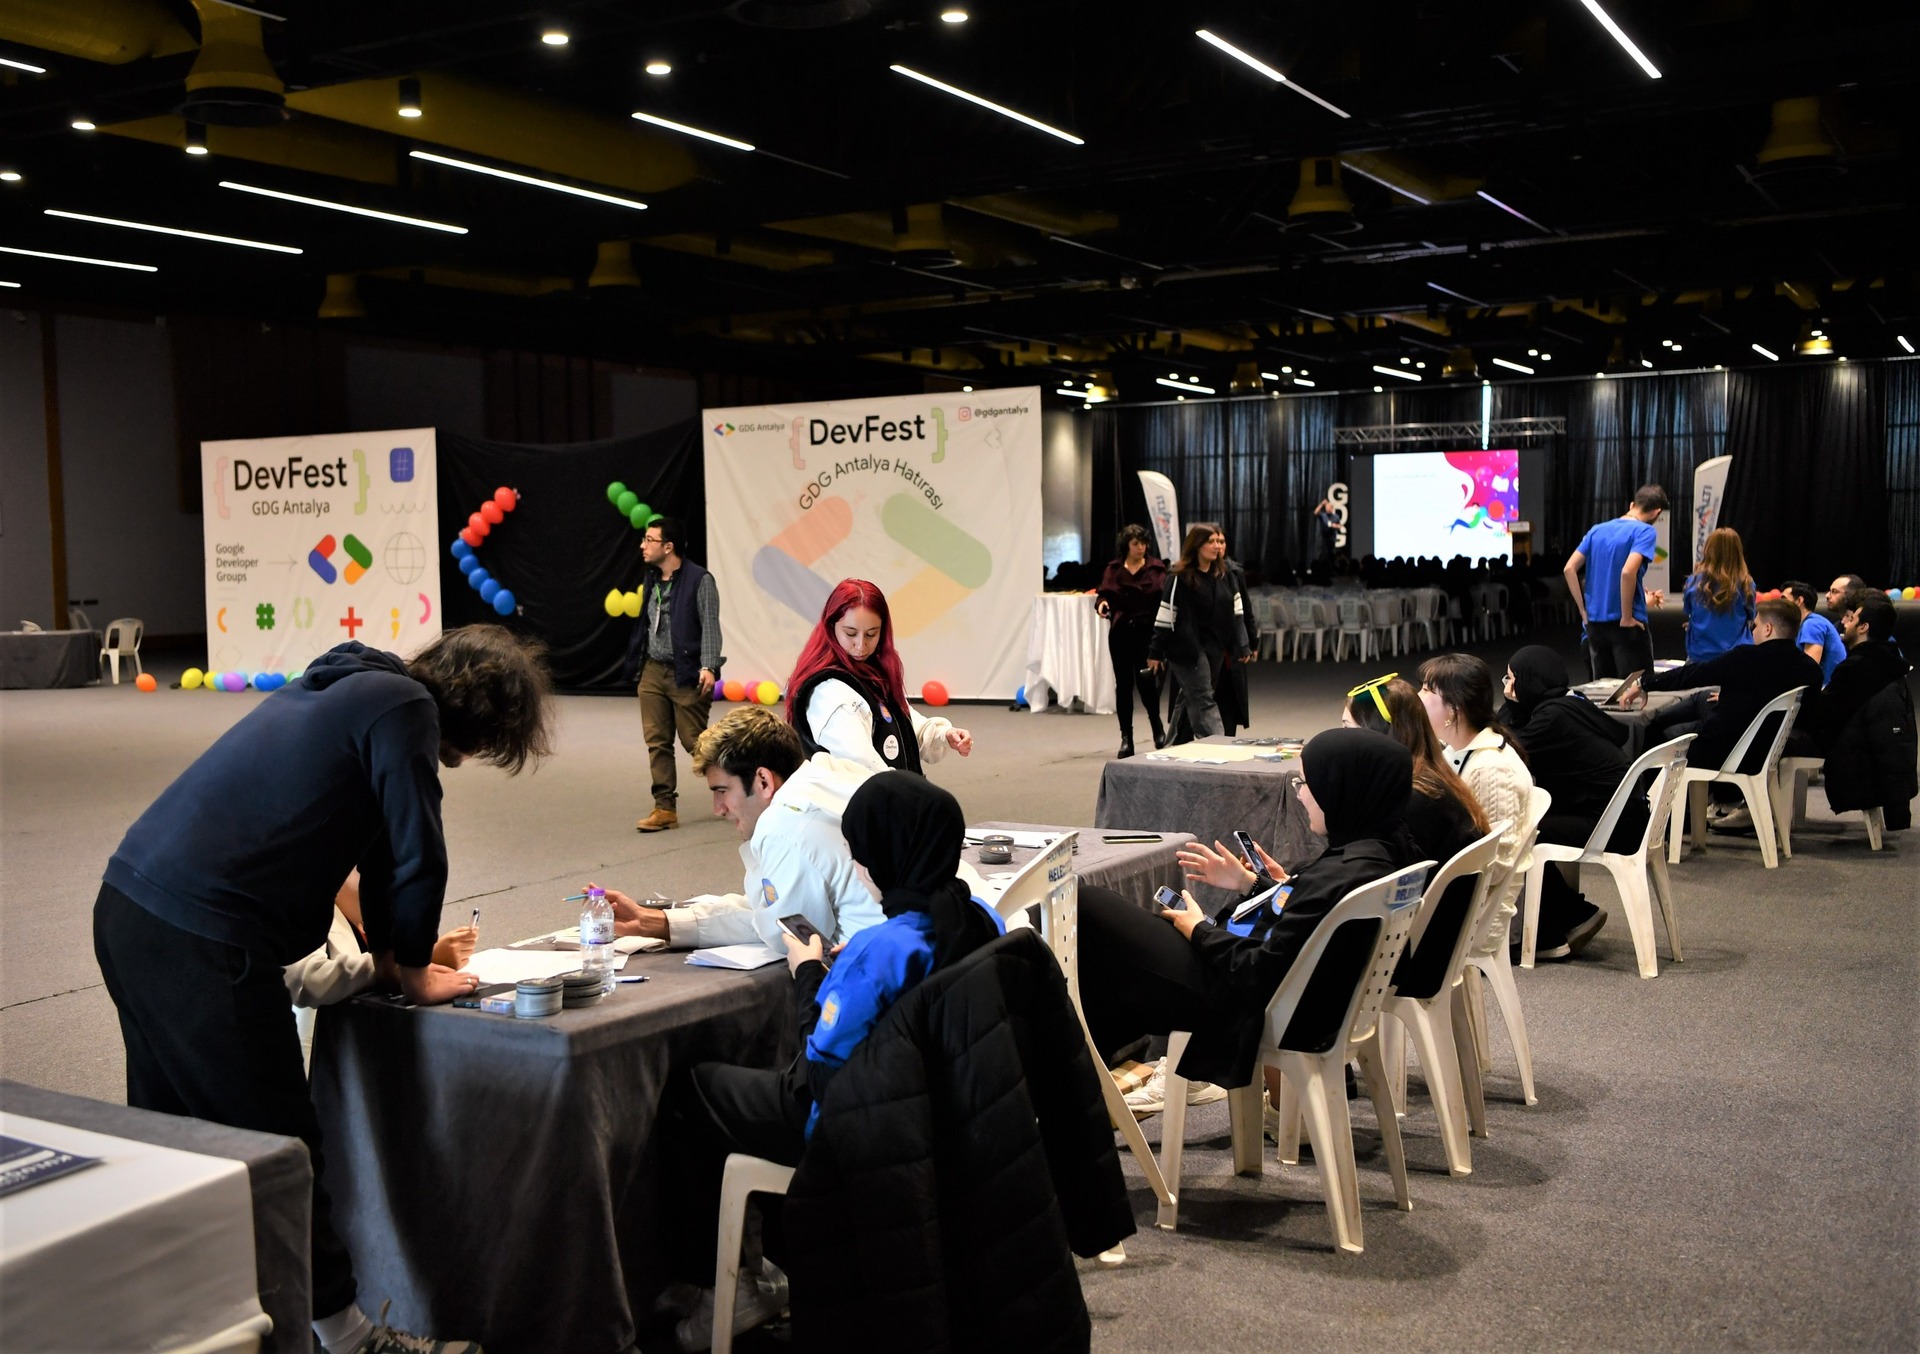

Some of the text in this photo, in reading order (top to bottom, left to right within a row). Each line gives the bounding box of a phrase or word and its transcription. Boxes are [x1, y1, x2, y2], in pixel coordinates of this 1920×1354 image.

[974, 406, 1029, 419] @gdgantalya
[738, 422, 786, 434] GDG Antalya
[809, 415, 926, 446] DevFest
[233, 456, 348, 491] DevFest
[799, 454, 944, 510] GDG Antalya Hatırası
[252, 499, 331, 518] GDG Antalya
[215, 543, 245, 556] Google
[216, 557, 259, 571] Developer
[216, 571, 247, 584] Groups
